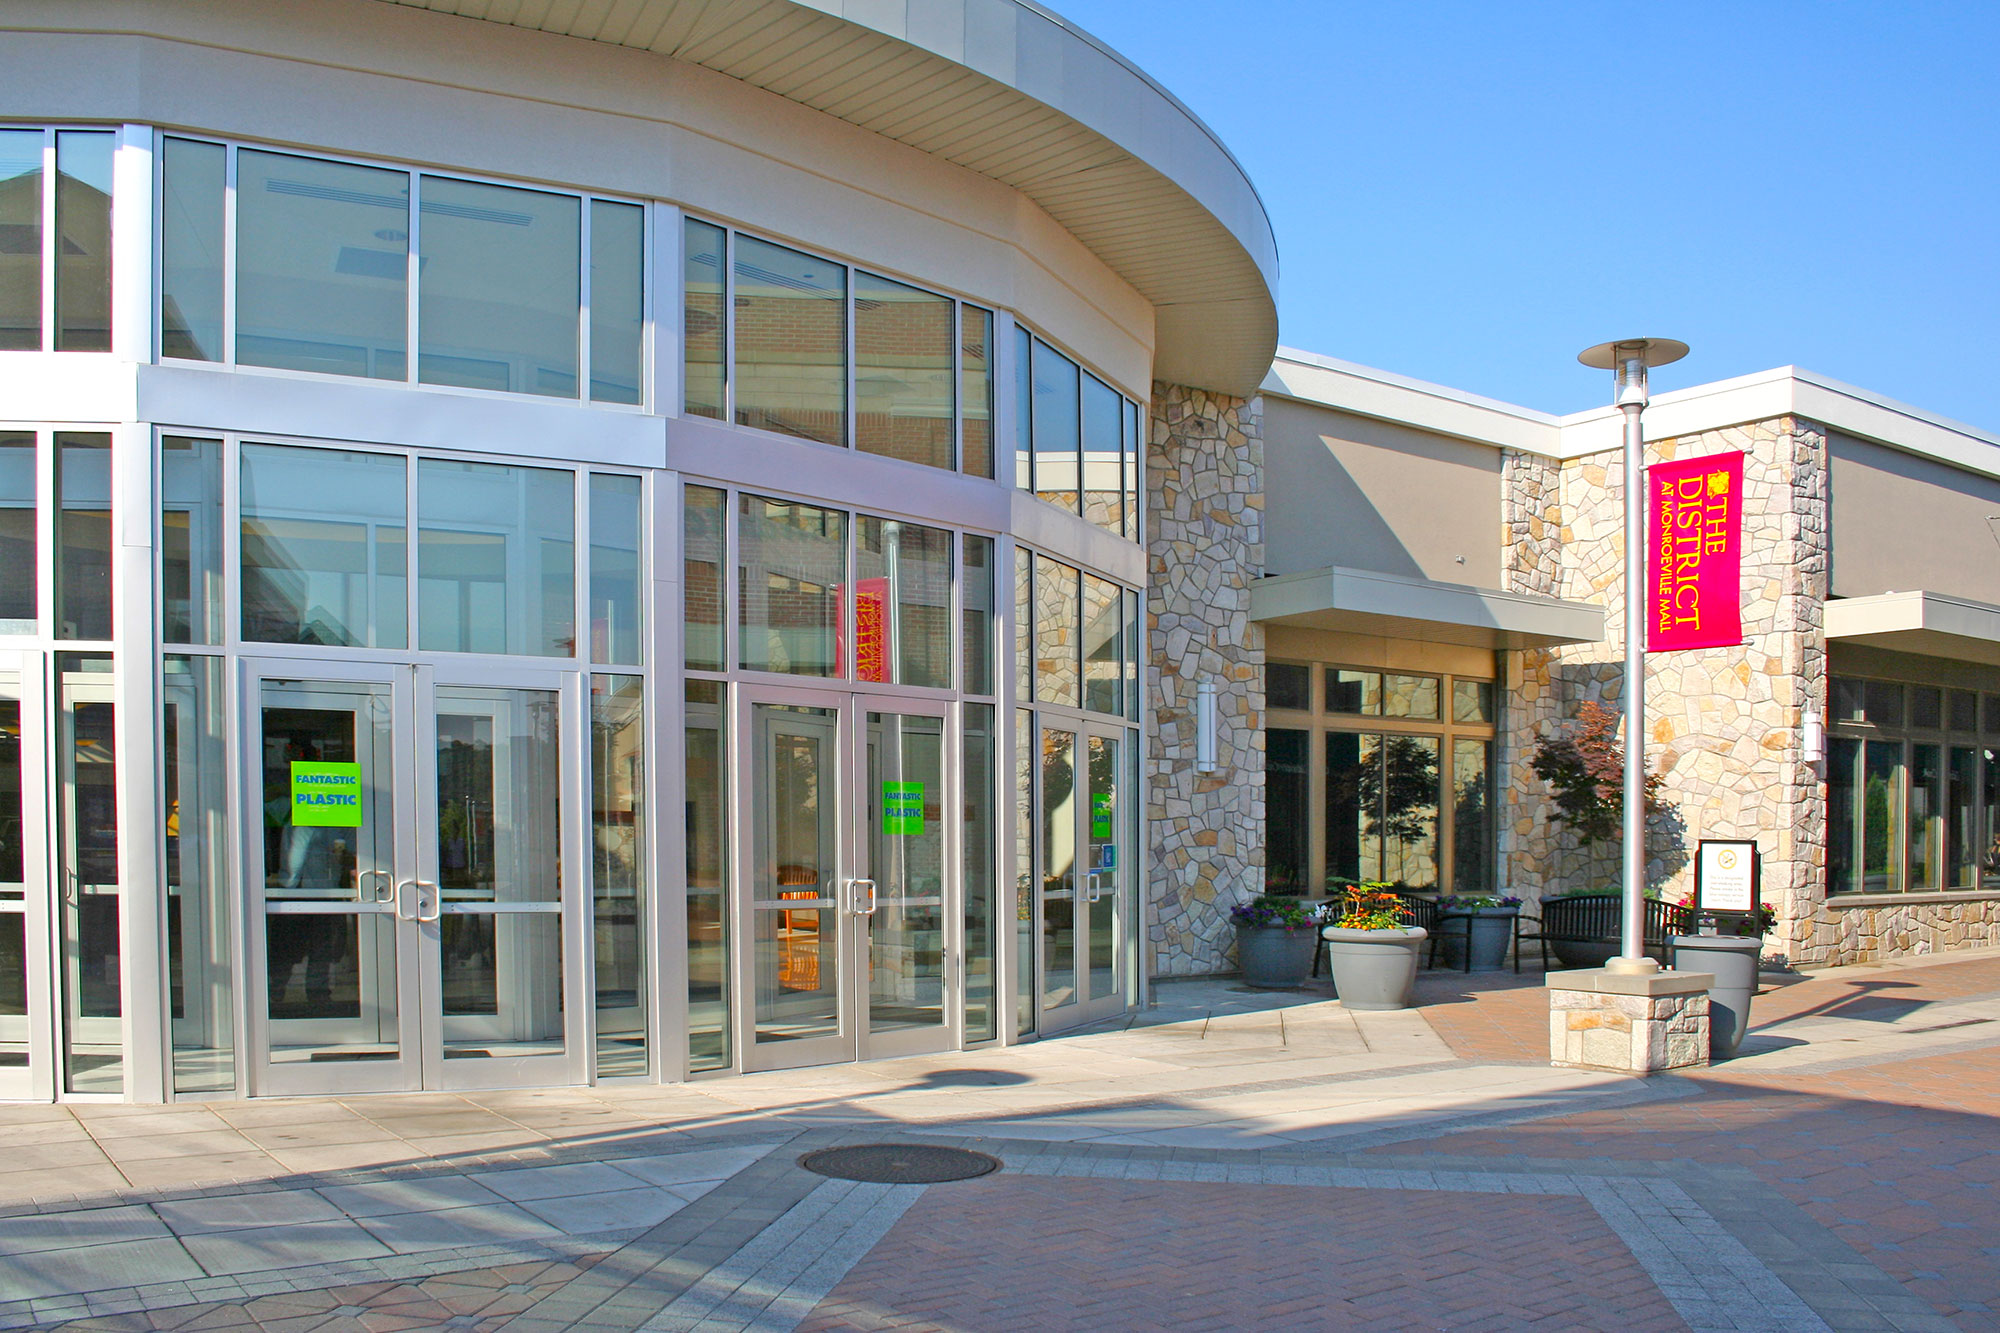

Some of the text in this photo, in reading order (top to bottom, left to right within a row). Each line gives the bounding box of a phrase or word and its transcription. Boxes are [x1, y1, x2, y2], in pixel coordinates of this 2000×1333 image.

[1705, 497, 1728, 555] THE
[1659, 481, 1674, 633] AT MONROEVILLE MALL
[1675, 475, 1703, 630] DISTRICT
[296, 775, 356, 784] FANTASTIC
[296, 794, 356, 805] PLASTIC
[885, 808, 921, 817] PLASTIC
